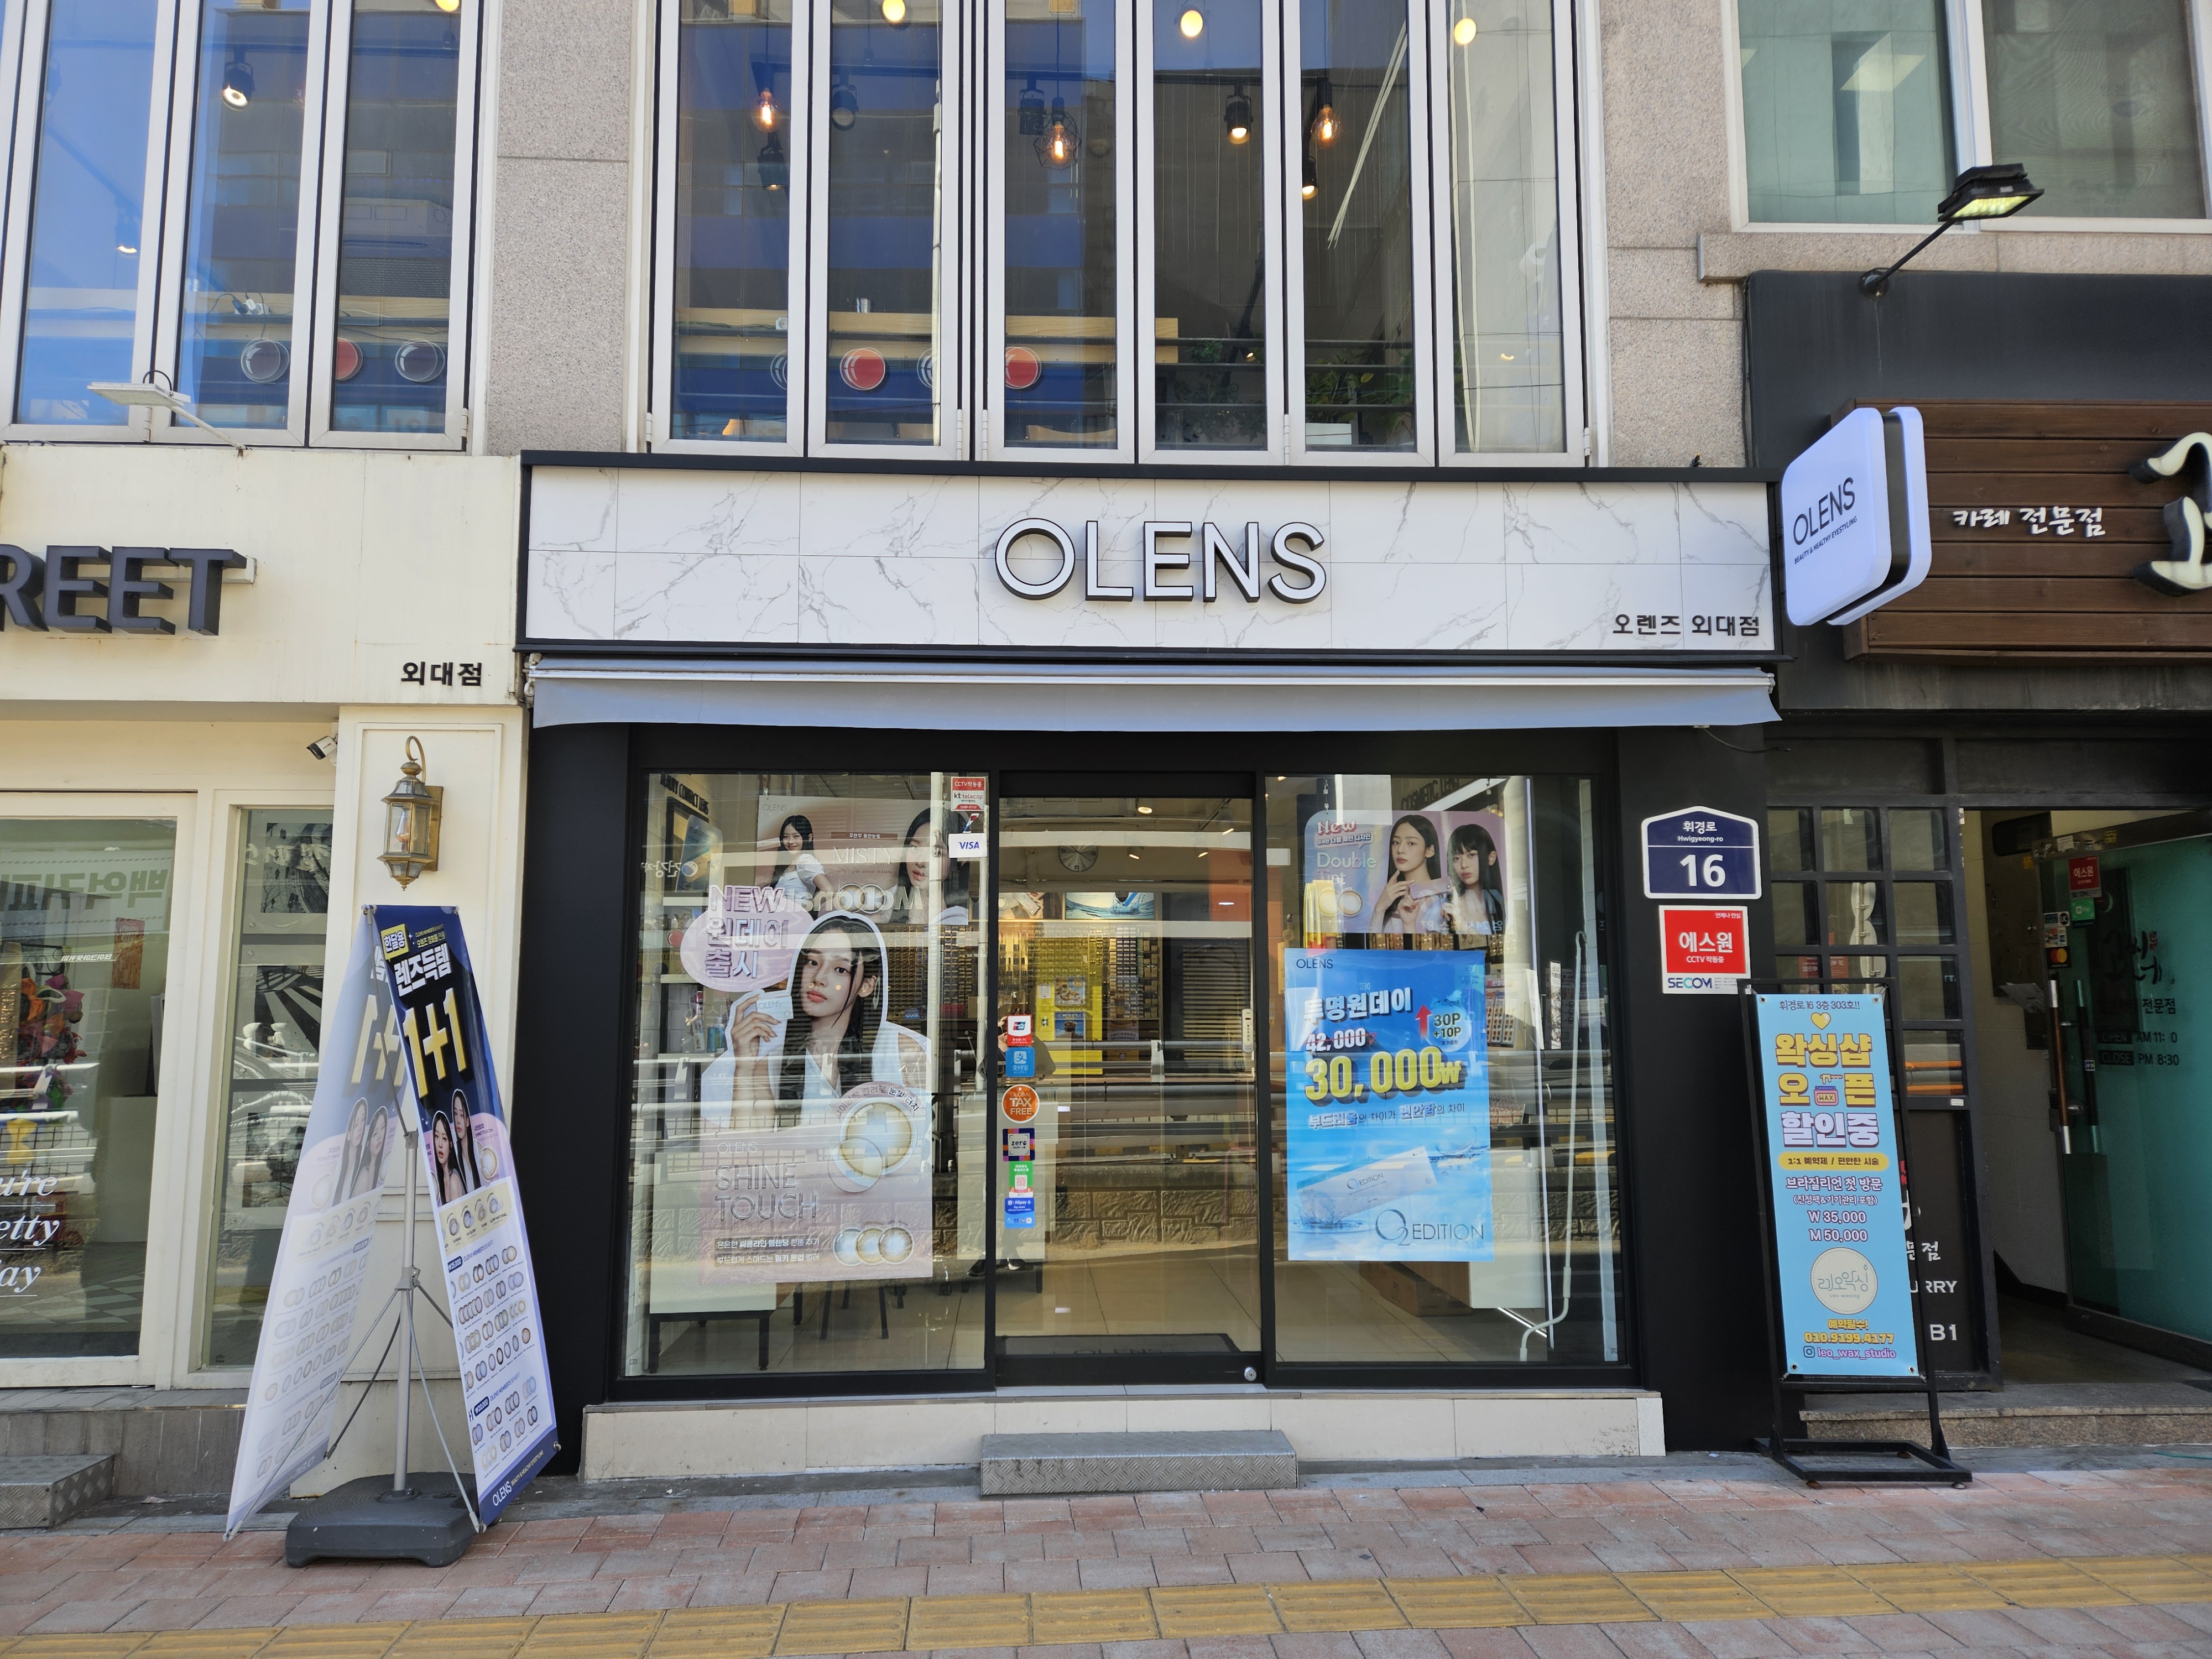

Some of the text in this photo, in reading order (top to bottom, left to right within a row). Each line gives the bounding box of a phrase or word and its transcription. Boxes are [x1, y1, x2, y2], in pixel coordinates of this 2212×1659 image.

[1793, 477, 1855, 546] OLENS
[1953, 506, 2106, 538] 카레 전문점
[1794, 549, 1809, 564] BEAUTY
[1813, 534, 1832, 551] HEALTHY
[1832, 515, 1858, 539] EYESTYLING
[994, 518, 1327, 604] OLENS
[1613, 613, 1760, 637] 오렌즈 외대점
[400, 660, 483, 687] 외대점
[762, 804, 787, 812] OLENS
[1316, 818, 1358, 836] New
[1683, 820, 1718, 834] 휘경로
[958, 841, 980, 850] VISA
[1354, 833, 1371, 841] 디자인
[832, 846, 898, 865] MISTY
[1317, 851, 1378, 869] Double
[1679, 854, 1726, 887] 16
[2074, 865, 2094, 878] 에스원
[708, 884, 786, 914] NEW
[706, 917, 789, 948] 원데이
[383, 930, 405, 954] 한달용
[1679, 931, 1733, 953] 에스원
[705, 950, 758, 979] 출시
[1296, 958, 1333, 969] OLENS
[1686, 955, 1725, 964] CCTV 작동중
[393, 942, 452, 997] 렌즈득템
[1667, 977, 1713, 989] SECOM
[758, 998, 782, 1010] OLENS
[1303, 987, 1414, 1024] 투명원데이
[1779, 1000, 1860, 1011] 휘경로 16 3층 303호!!
[2142, 998, 2176, 1015] 전문점
[1433, 1013, 1461, 1026] 30P
[1306, 1027, 1366, 1053] 42,000
[1433, 1027, 1462, 1040] +10P
[2102, 1032, 2152, 1043] OPEN AM
[403, 987, 467, 1099] 1+1
[1775, 1033, 1873, 1068] 왁싱샵
[2102, 1052, 2180, 1066] CLOSE PM 8:30
[888, 1086, 906, 1100] 눈빛
[904, 1094, 921, 1112] 터치
[1009, 1097, 1031, 1107] TAX
[1308, 1102, 1465, 1130] 부드러움의 차이가 편안함의 차이
[1780, 1111, 1880, 1148] 할인중
[717, 1141, 758, 1154] OLENS
[1804, 1157, 1828, 1166] 예약제
[1837, 1157, 1861, 1166] 편안한
[1864, 1157, 1880, 1166] 시술
[714, 1162, 797, 1191] SHINE
[1359, 1172, 1385, 1187] EDITION
[1786, 1176, 1883, 1192] 브라질리언 첫 방문
[714, 1193, 817, 1221] TOUCH
[1793, 1194, 1879, 1206] (진정팩&기기관리 포함)
[1823, 1210, 1867, 1224] 35,000
[1412, 1223, 1484, 1240] EDITION
[1809, 1229, 1869, 1243] M 50,000
[717, 1255, 745, 1264] 부드럽게
[746, 1254, 773, 1264] 스며드는
[775, 1253, 789, 1262] 밀키
[1827, 1318, 1869, 1331] 예약필수!
[1804, 1332, 1895, 1344] 010.9199.4177
[1817, 1347, 1897, 1360] leo_wax_studio
[489, 1390, 499, 1401] OLENS
[492, 1480, 512, 1506] OLENS
